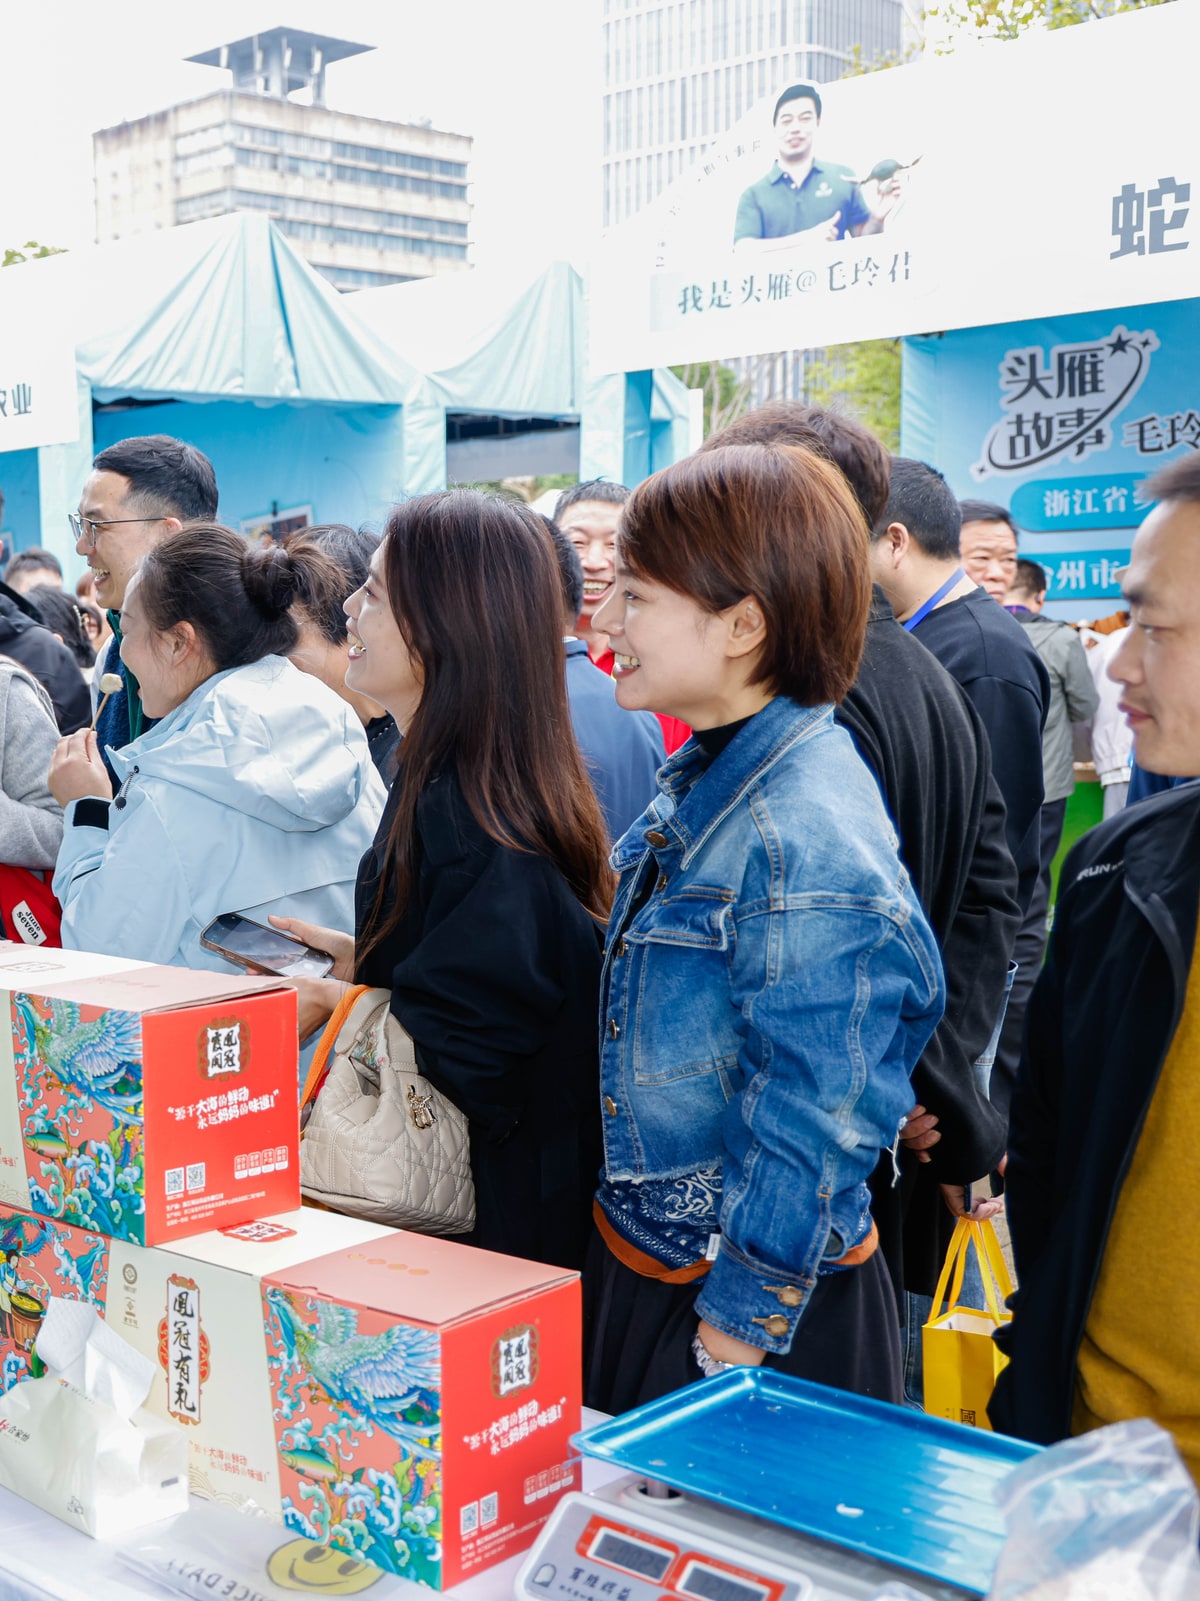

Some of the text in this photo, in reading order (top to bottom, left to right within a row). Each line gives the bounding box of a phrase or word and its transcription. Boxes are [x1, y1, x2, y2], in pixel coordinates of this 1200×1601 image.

[1109, 176, 1191, 260] 蛇
[1005, 346, 1106, 404] 头雁
[1007, 407, 1106, 461] 故事
[16, 911, 39, 940] seven
[25, 911, 41, 932] June
